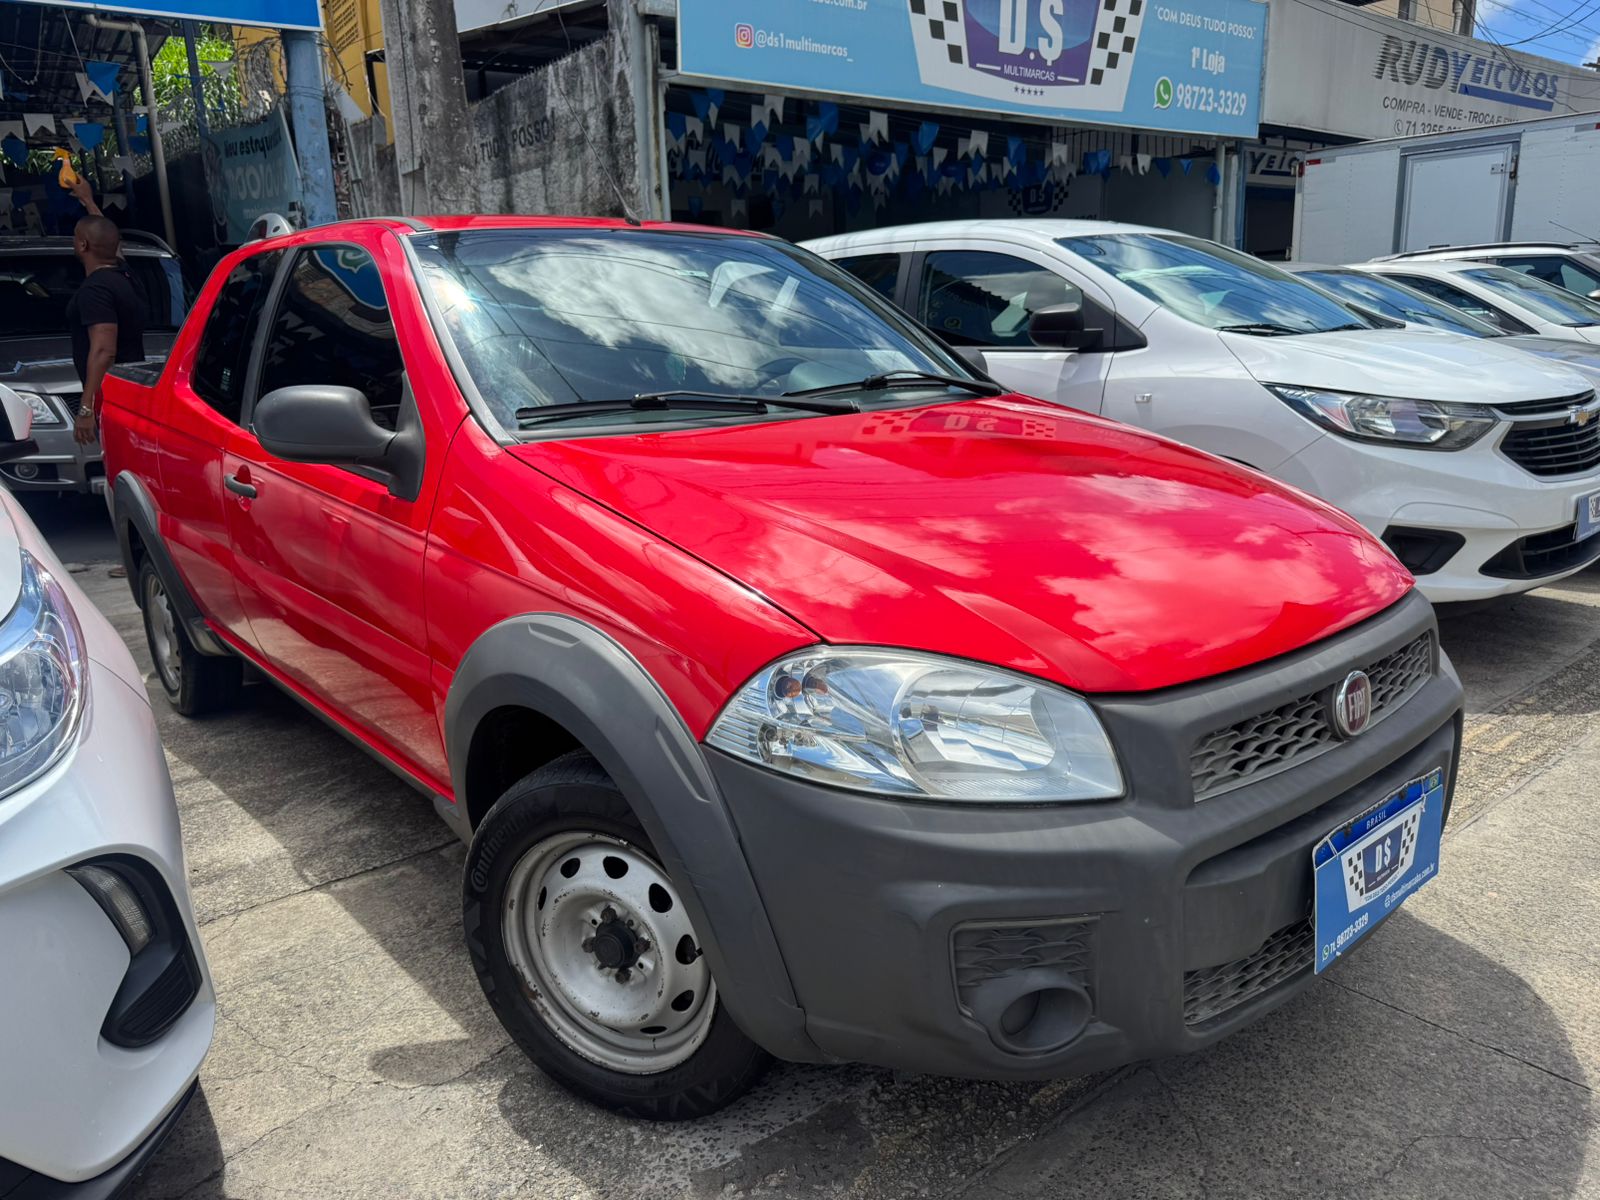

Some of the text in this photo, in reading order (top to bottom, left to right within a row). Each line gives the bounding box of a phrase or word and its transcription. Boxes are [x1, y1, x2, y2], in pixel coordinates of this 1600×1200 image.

[1179, 12, 1201, 28] DEUS
[1203, 17, 1226, 33] TUDO
[1003, 64, 1056, 81] MULTIMARCAS
[1202, 48, 1225, 75] Loja
[1176, 83, 1247, 116] 98723-3329
[1382, 96, 1426, 116] COMPRA
[1434, 104, 1463, 121] VENDE
[1347, 687, 1366, 722] FIAT
[1366, 810, 1387, 830] BRASIL
